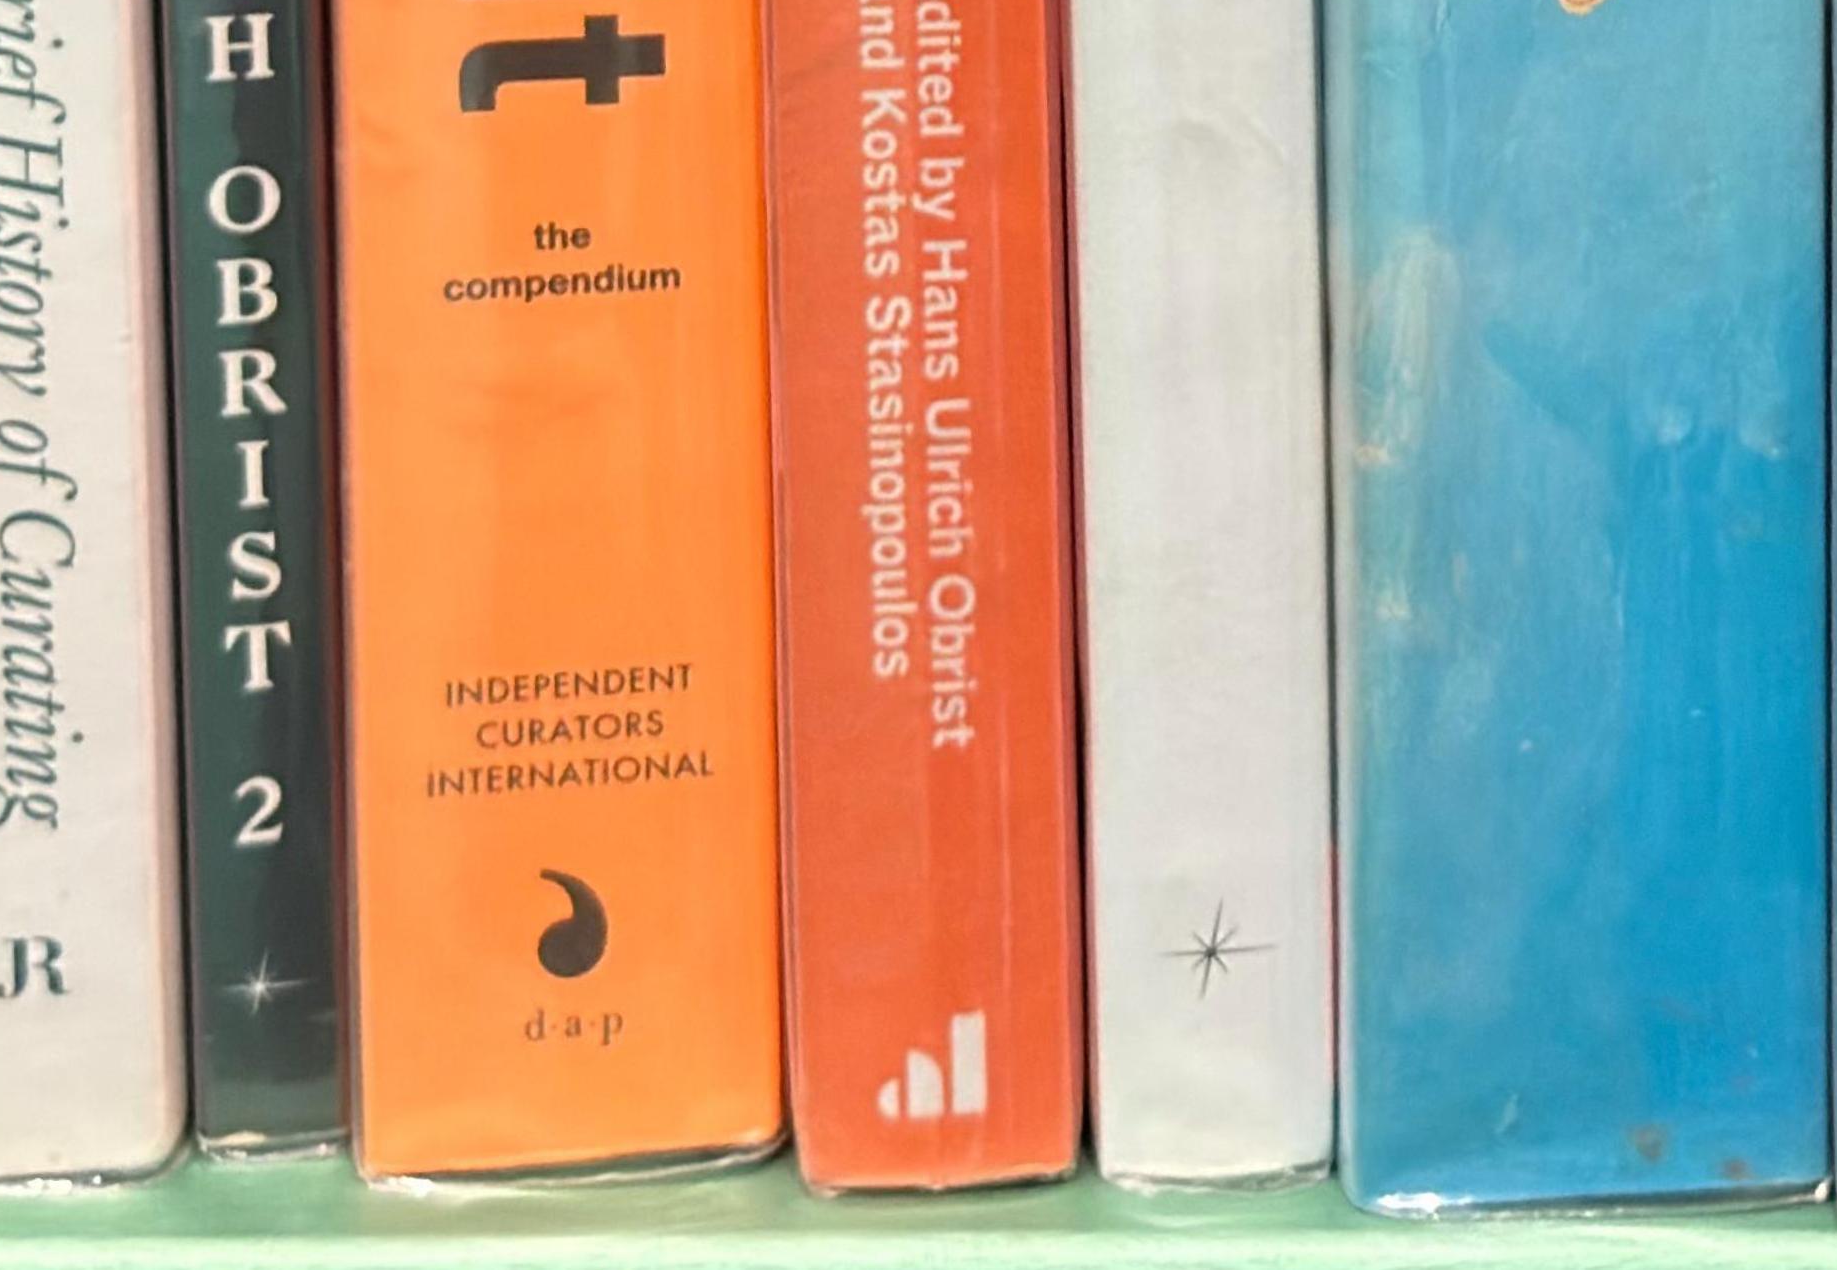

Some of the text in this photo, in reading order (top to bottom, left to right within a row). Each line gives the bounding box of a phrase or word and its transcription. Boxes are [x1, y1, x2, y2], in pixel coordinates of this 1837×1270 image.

[534, 222, 590, 251] the
[444, 264, 680, 303] compendium
[922, 240, 969, 379] Hans
[208, 166, 293, 690] OBRIST
[862, 87, 916, 676] Kostas Stasinopoulos
[926, 398, 975, 556] Ulrich
[445, 663, 694, 706] INDEPENDENT
[930, 574, 979, 748] Obrist
[426, 750, 714, 797] INTERNATIONAL
[476, 710, 664, 749] CURATORS
